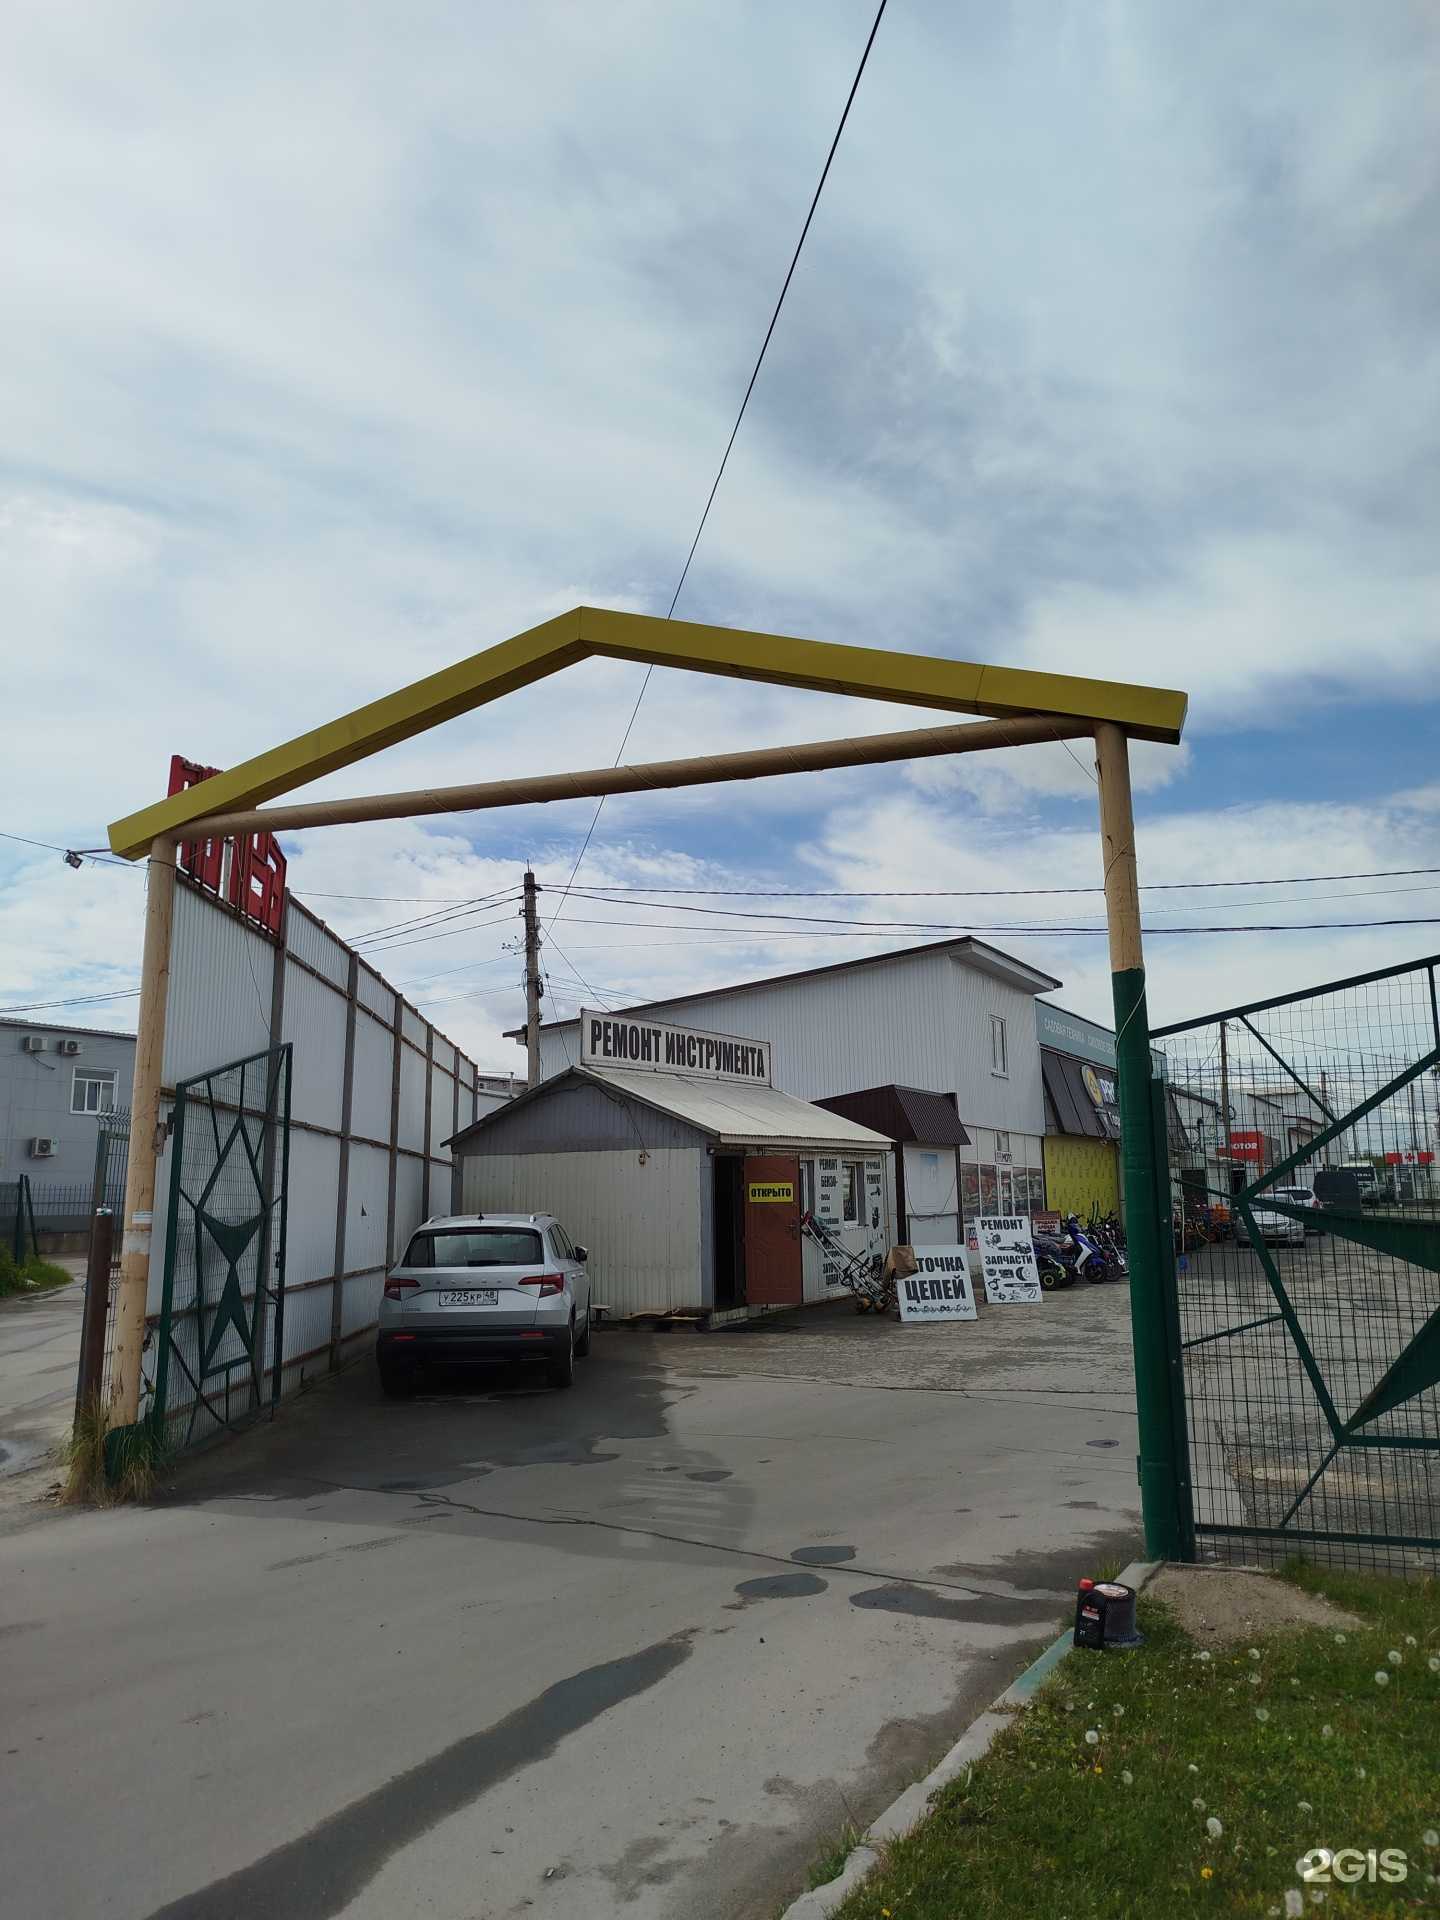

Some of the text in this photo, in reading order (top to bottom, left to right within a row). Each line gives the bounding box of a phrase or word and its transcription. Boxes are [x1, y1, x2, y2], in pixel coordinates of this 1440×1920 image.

[591, 1019, 765, 1078] РЕМОНТ ИНСТРУМЕНТА
[751, 1187, 792, 1198] ОТКРЫТО
[980, 1218, 1024, 1231] РЕМОНТ
[916, 1256, 965, 1273] ТОЧКА
[985, 1255, 1033, 1266] ЗАПЧАСТИ
[904, 1275, 967, 1304] ЦЕПЕЙ
